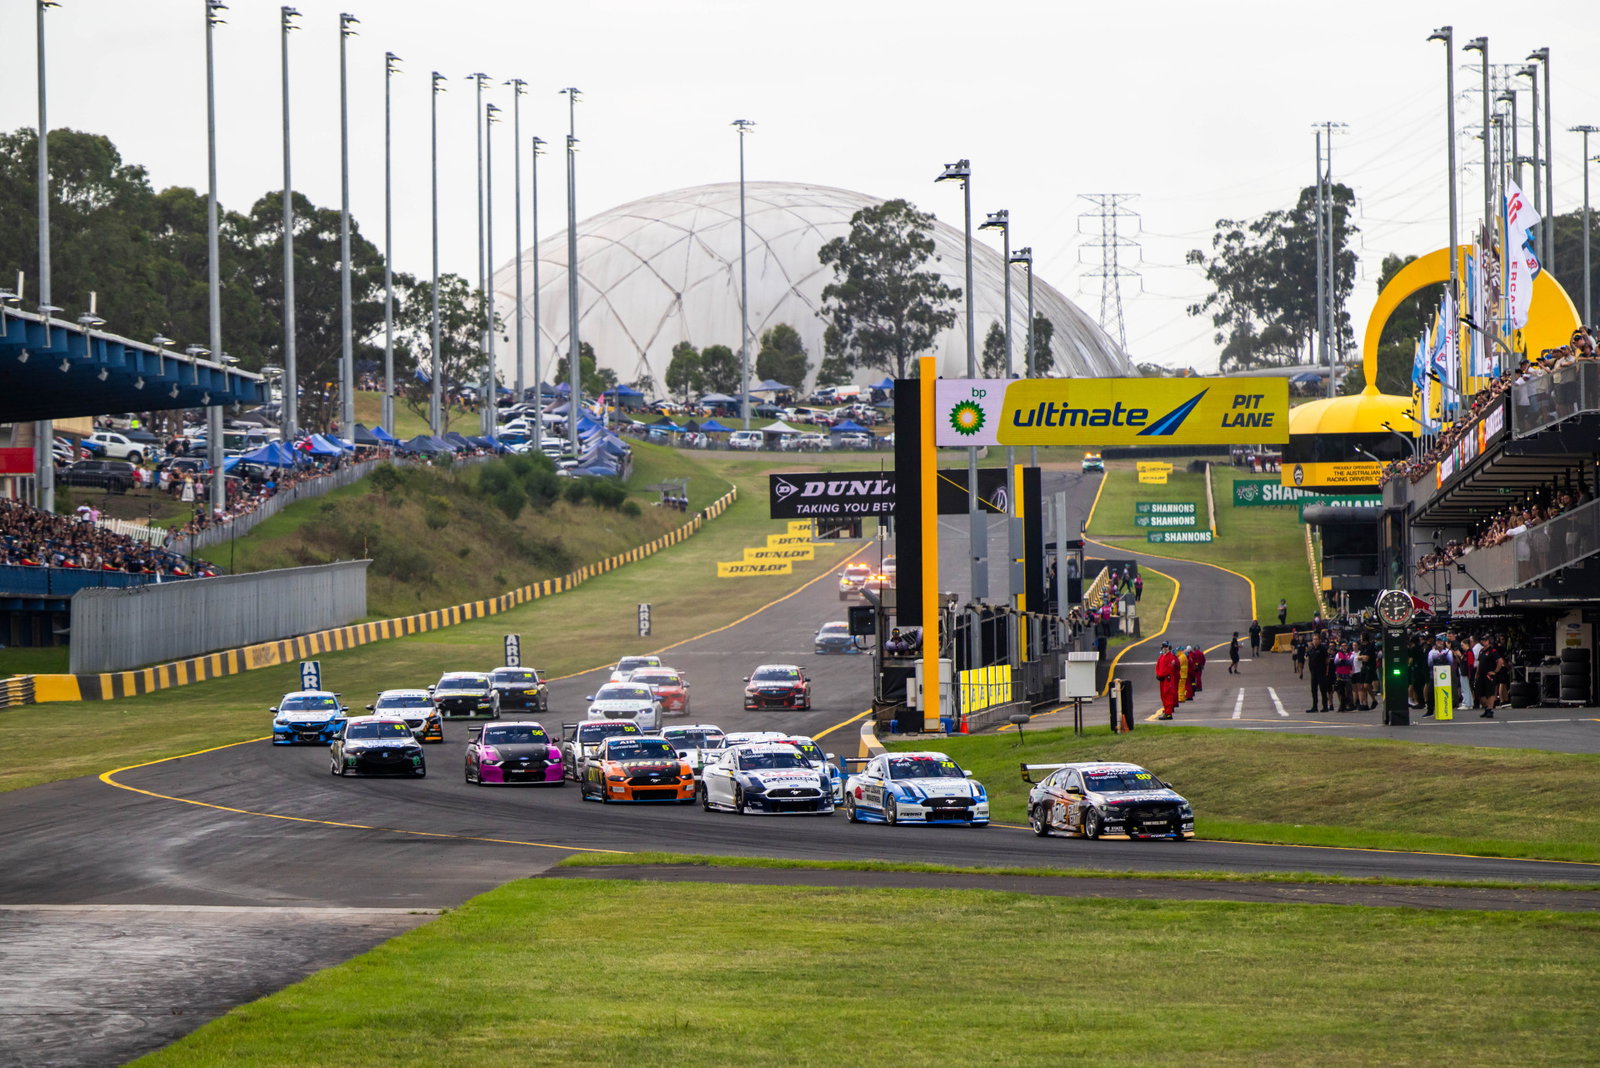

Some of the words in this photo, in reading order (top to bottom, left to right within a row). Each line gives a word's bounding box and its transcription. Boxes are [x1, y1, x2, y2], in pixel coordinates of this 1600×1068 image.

[971, 387, 987, 399] bp
[1232, 394, 1264, 409] PIT
[1013, 402, 1149, 427] ultimate
[1221, 413, 1275, 428] LANE
[800, 480, 896, 497] DUNL
[796, 504, 840, 514] TAKING
[844, 503, 869, 512] YOU
[1151, 504, 1195, 513] SHANNONS
[1151, 516, 1196, 526] SHANNONS
[1164, 532, 1212, 542] SHANNONS
[754, 550, 810, 559] DUNLOP
[728, 564, 787, 573] DUNLOP
